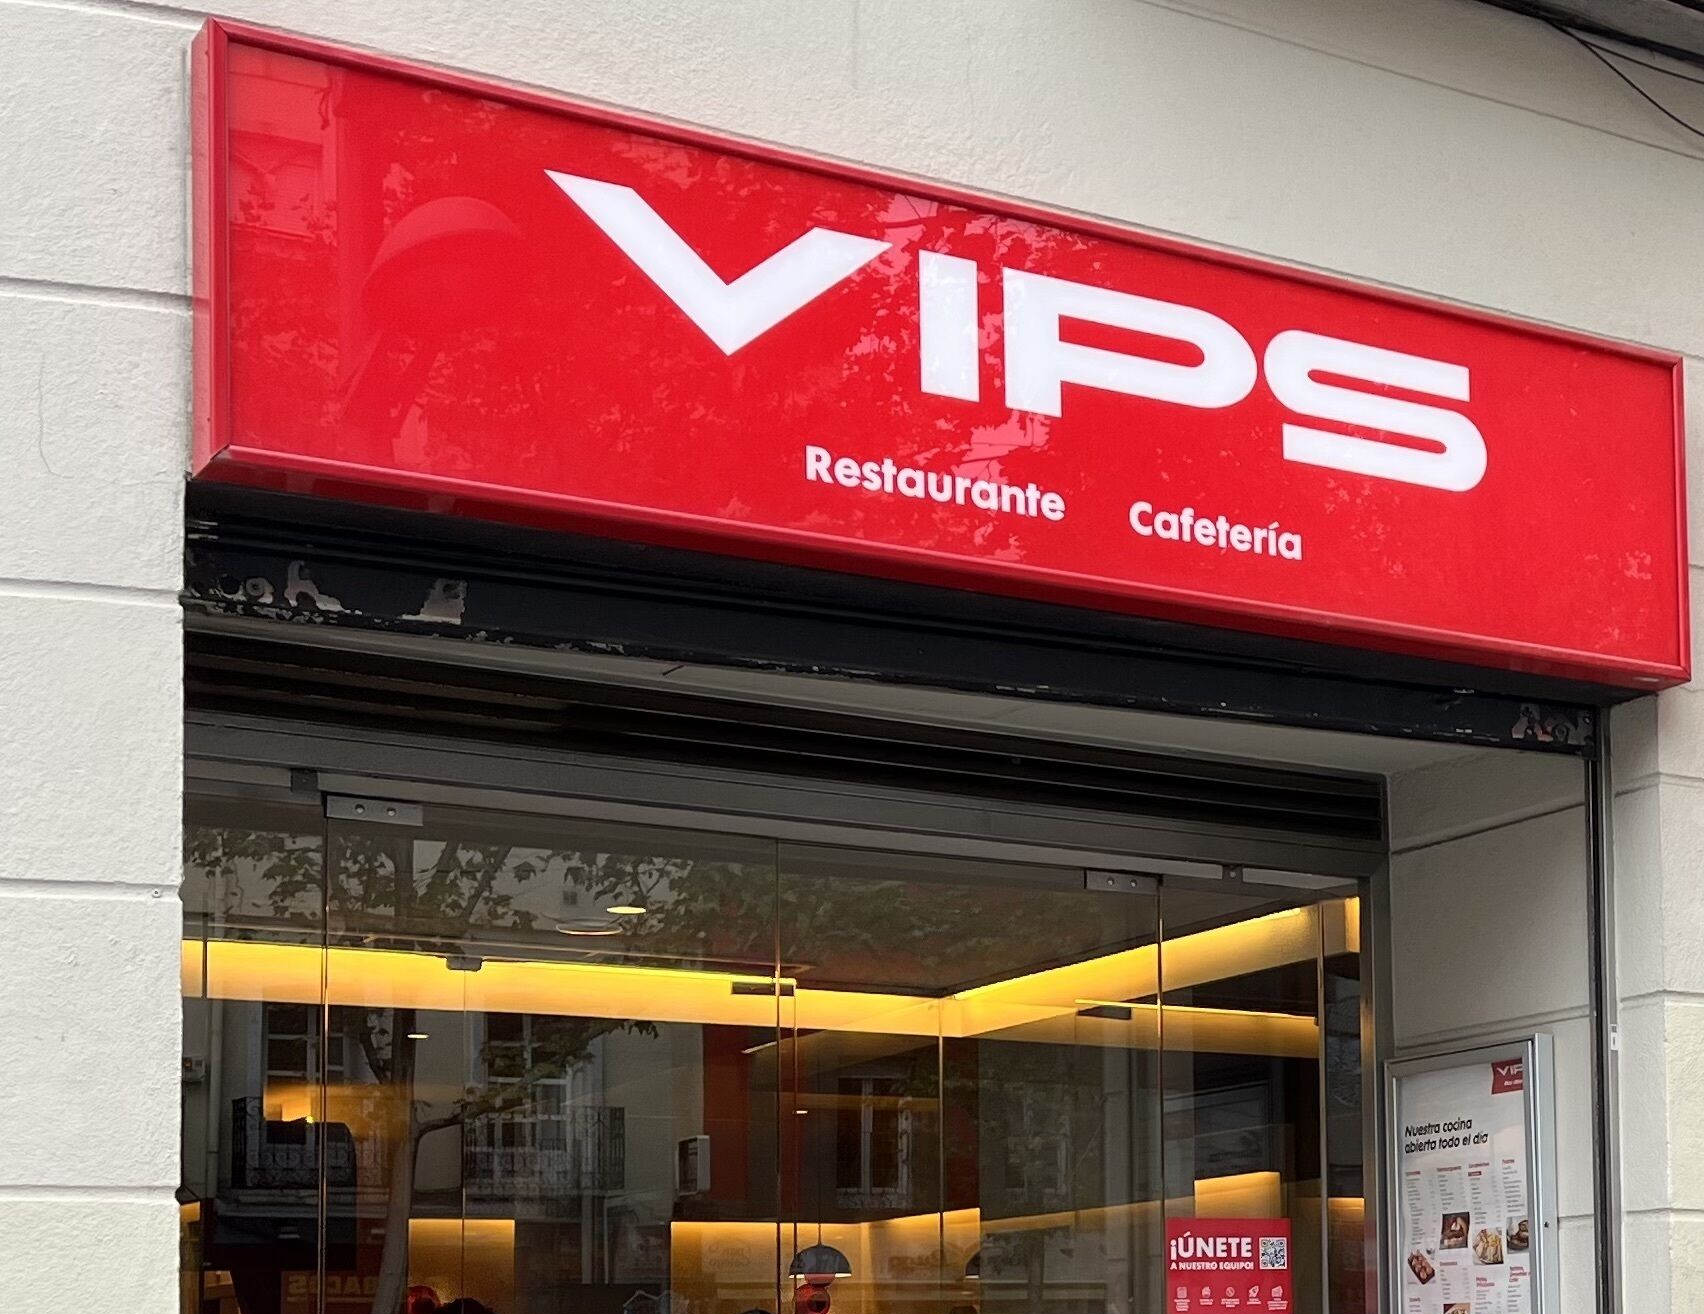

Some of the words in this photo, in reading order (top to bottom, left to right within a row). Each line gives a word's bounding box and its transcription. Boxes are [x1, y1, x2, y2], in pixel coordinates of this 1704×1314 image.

[543, 168, 1489, 493] VIPS
[804, 443, 1067, 523] Restaurante
[1127, 500, 1304, 562] Cafetería
[1496, 1063, 1524, 1077] VIP
[1404, 1121, 1441, 1138] Nuestra
[1442, 1116, 1473, 1132] cocina
[1404, 1137, 1437, 1154] abierta
[1438, 1135, 1460, 1150] todo
[1462, 1135, 1471, 1146] el
[1170, 1231, 1253, 1261] ¡ÚNETE
[1170, 1262, 1178, 1271] A
[1179, 1261, 1218, 1271] NUESTRO
[1219, 1261, 1254, 1271] EQUIPO!
